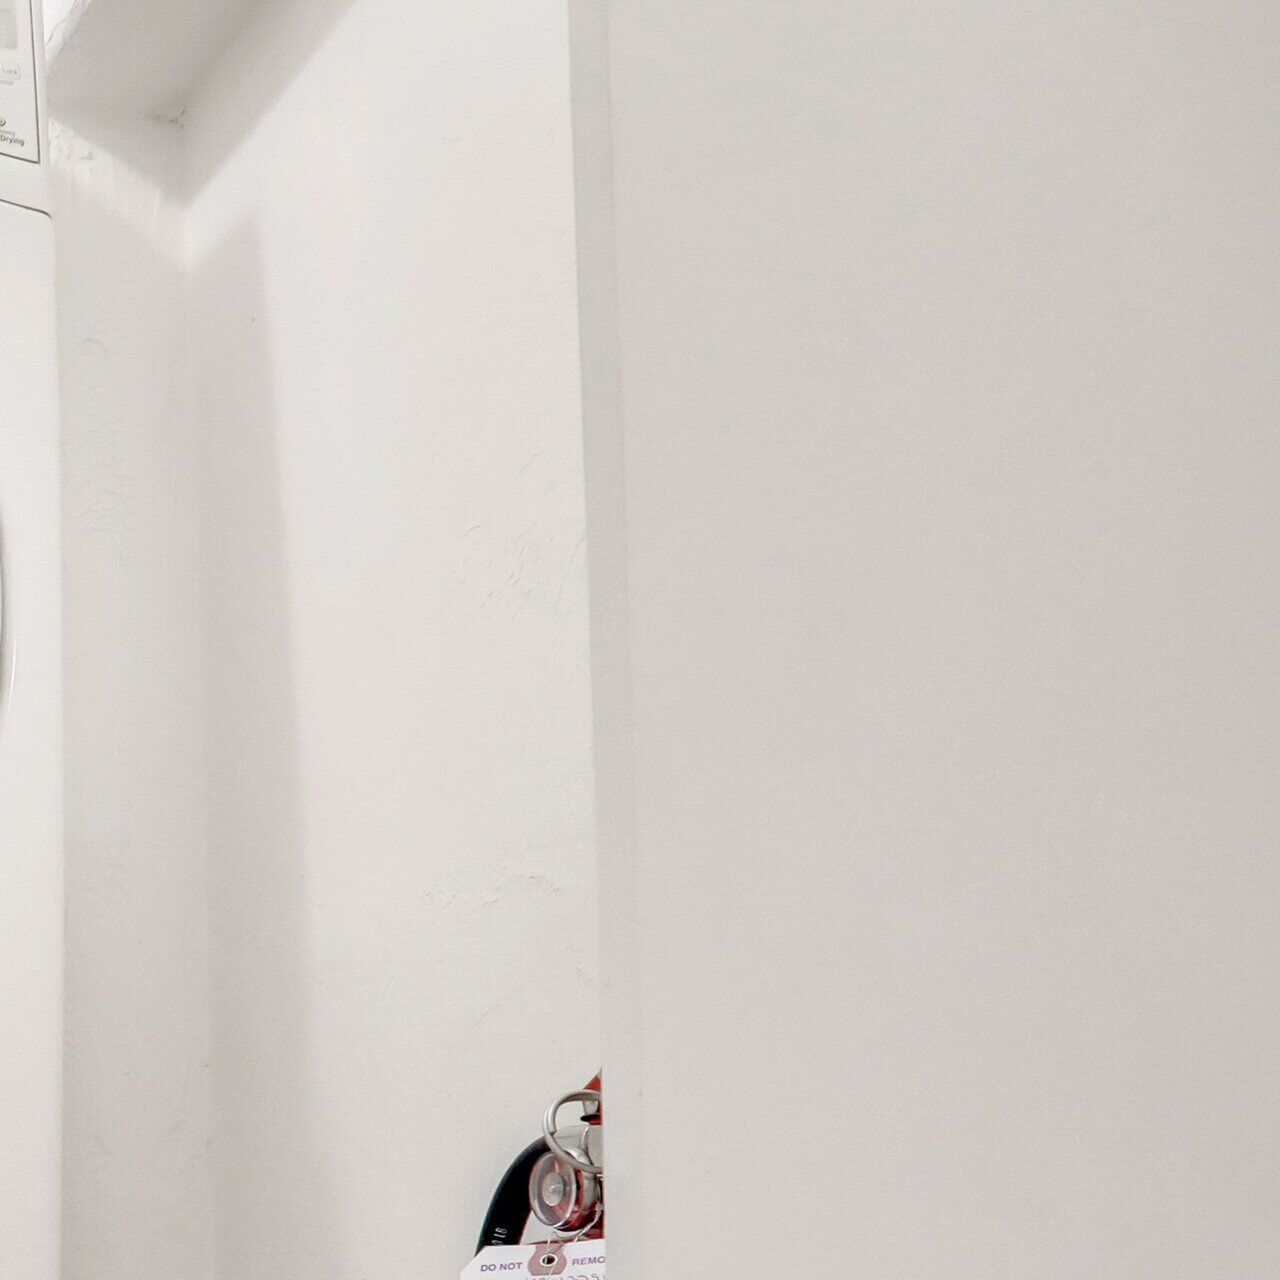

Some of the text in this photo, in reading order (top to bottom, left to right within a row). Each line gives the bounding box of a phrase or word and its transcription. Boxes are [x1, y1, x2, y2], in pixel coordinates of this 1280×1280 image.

[2, 66, 18, 75] Lock
[480, 1264, 496, 1272] DO
[500, 1262, 523, 1270] NOT
